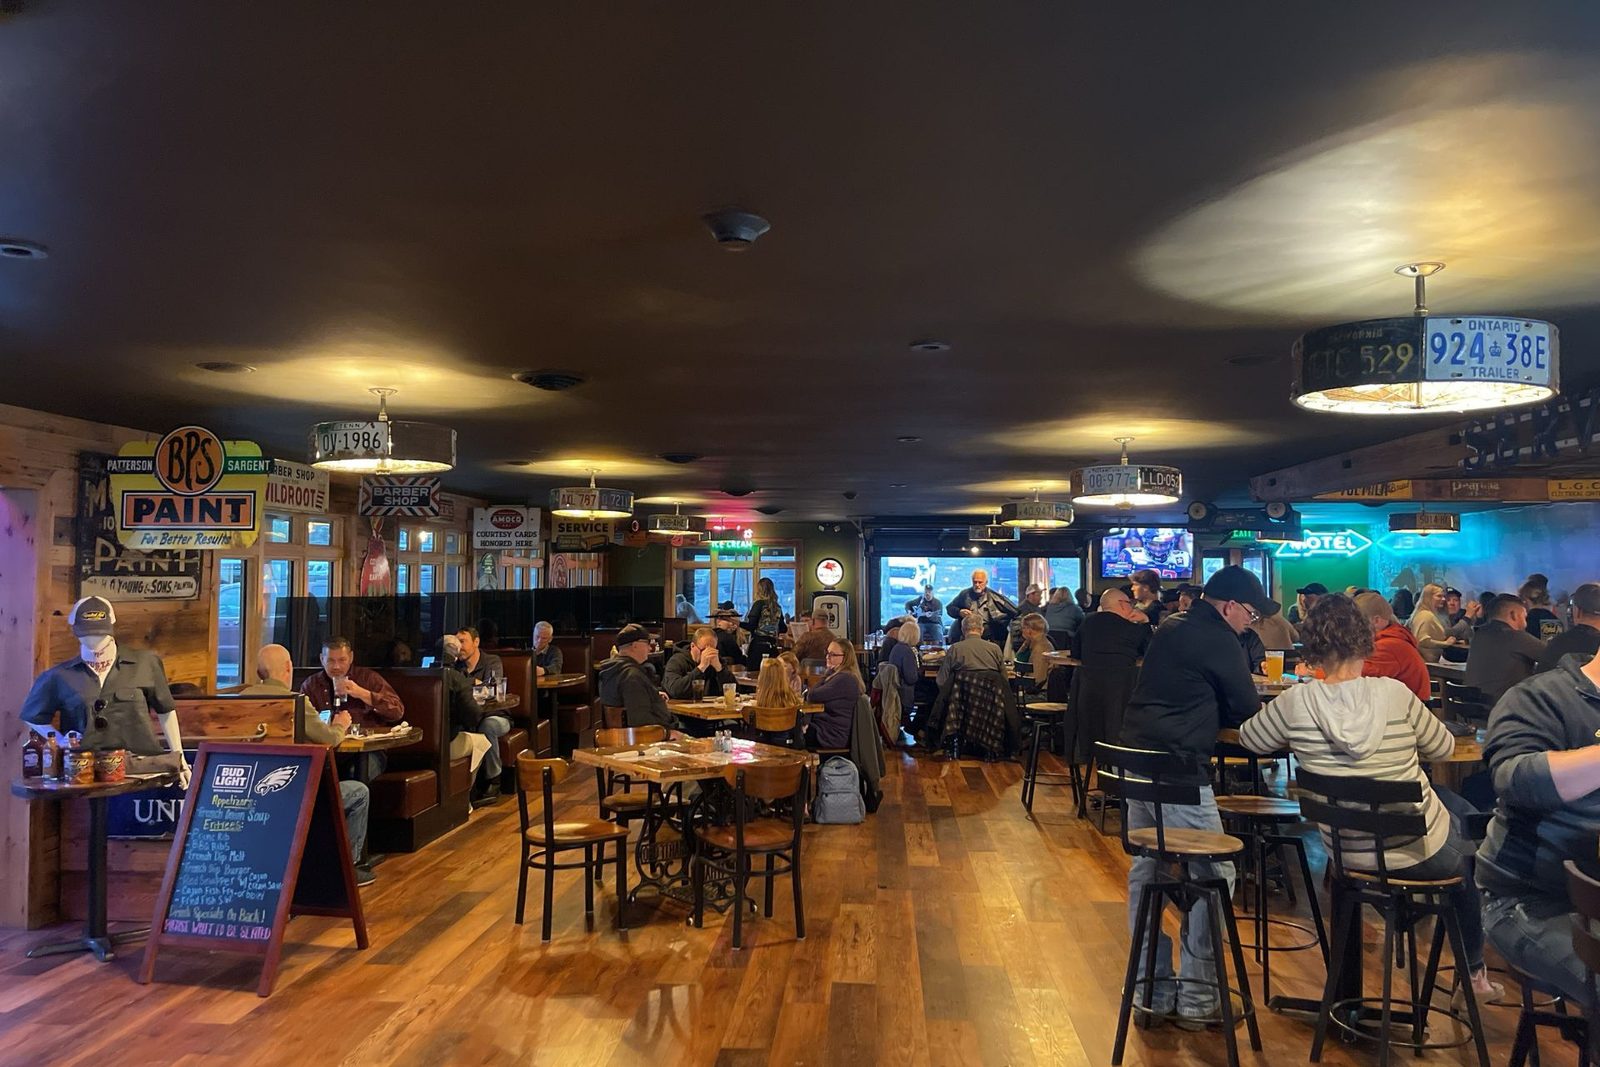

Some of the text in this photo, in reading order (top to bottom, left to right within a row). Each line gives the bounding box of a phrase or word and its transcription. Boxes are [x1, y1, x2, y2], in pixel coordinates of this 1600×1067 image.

[1469, 320, 1520, 332] ONTARIO
[1430, 332, 1545, 369] 924 38E
[1360, 342, 1415, 375] 529
[1470, 366, 1519, 379] TRAILER
[107, 459, 153, 471] PATTERSON
[166, 431, 216, 491] BPS
[227, 460, 270, 472] SARGENT
[296, 469, 315, 480] SHOP
[374, 487, 429, 496] BARBER
[384, 497, 419, 505] SHOP
[133, 498, 247, 523] PAINT
[492, 515, 522, 523] AMOCO
[558, 523, 609, 533] SERVICE
[140, 532, 231, 545] For Better Results
[94, 537, 200, 572] PAINT
[221, 767, 245, 777] BUD
[215, 776, 247, 787] LIGHT
[247, 809, 271, 825] Soup
